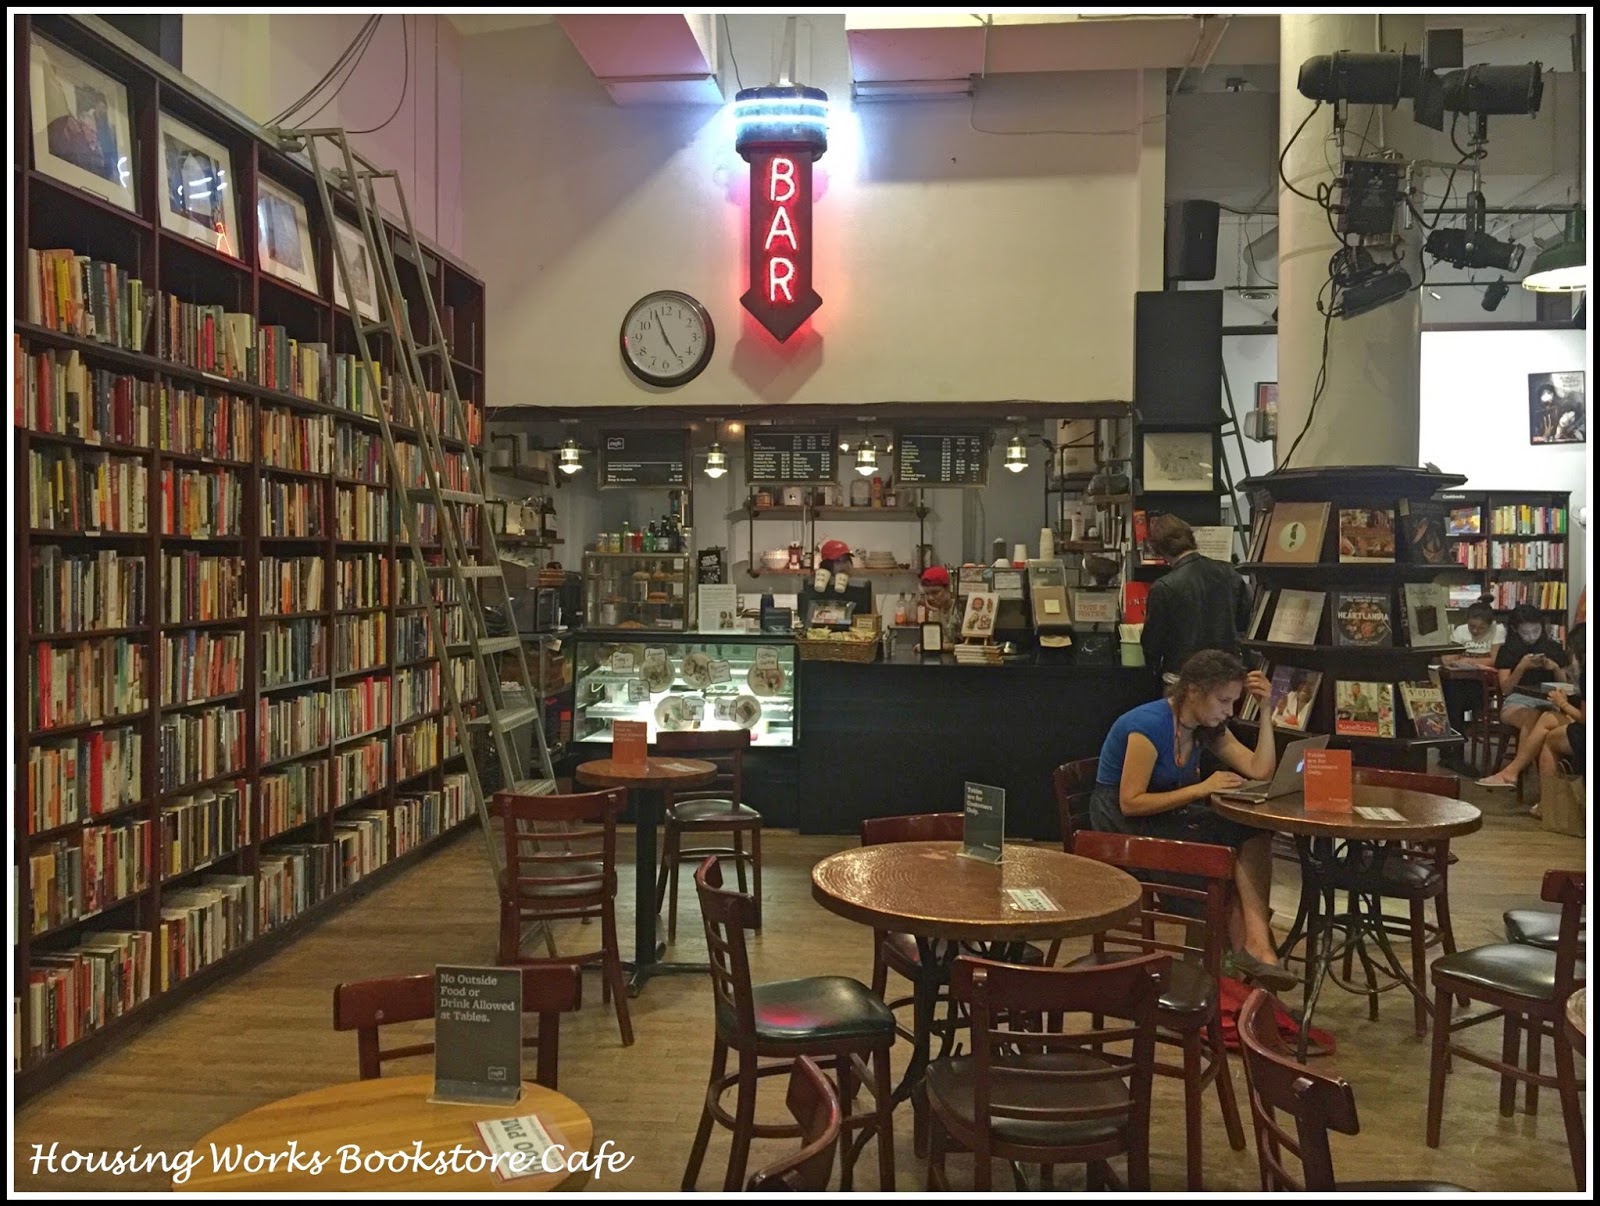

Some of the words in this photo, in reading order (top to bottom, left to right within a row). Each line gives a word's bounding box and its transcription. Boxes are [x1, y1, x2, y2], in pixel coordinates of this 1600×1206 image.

[765, 157, 797, 302] BAR
[662, 306, 672, 316] 12
[678, 309, 682, 319] 1
[640, 321, 650, 330] 10
[686, 318, 692, 328] 2
[635, 332, 642, 342] 9
[692, 332, 697, 342] 3
[640, 346, 647, 356] 8
[686, 346, 692, 356] 4
[650, 356, 656, 366] 7
[662, 360, 670, 370] 6
[678, 356, 684, 366] 5
[1338, 611, 1389, 621] HEARTLANDIA
[967, 786, 982, 795] Tables
[966, 800, 993, 811] Customers
[440, 973, 455, 984] No
[457, 974, 498, 986] Outside
[440, 986, 466, 996] Food
[468, 988, 480, 997] or
[440, 998, 470, 1010] Drink
[472, 1000, 515, 1012] Allowed
[440, 1012, 450, 1020] at
[453, 1011, 490, 1022] Tables.
[499, 1118, 528, 1139] PM
